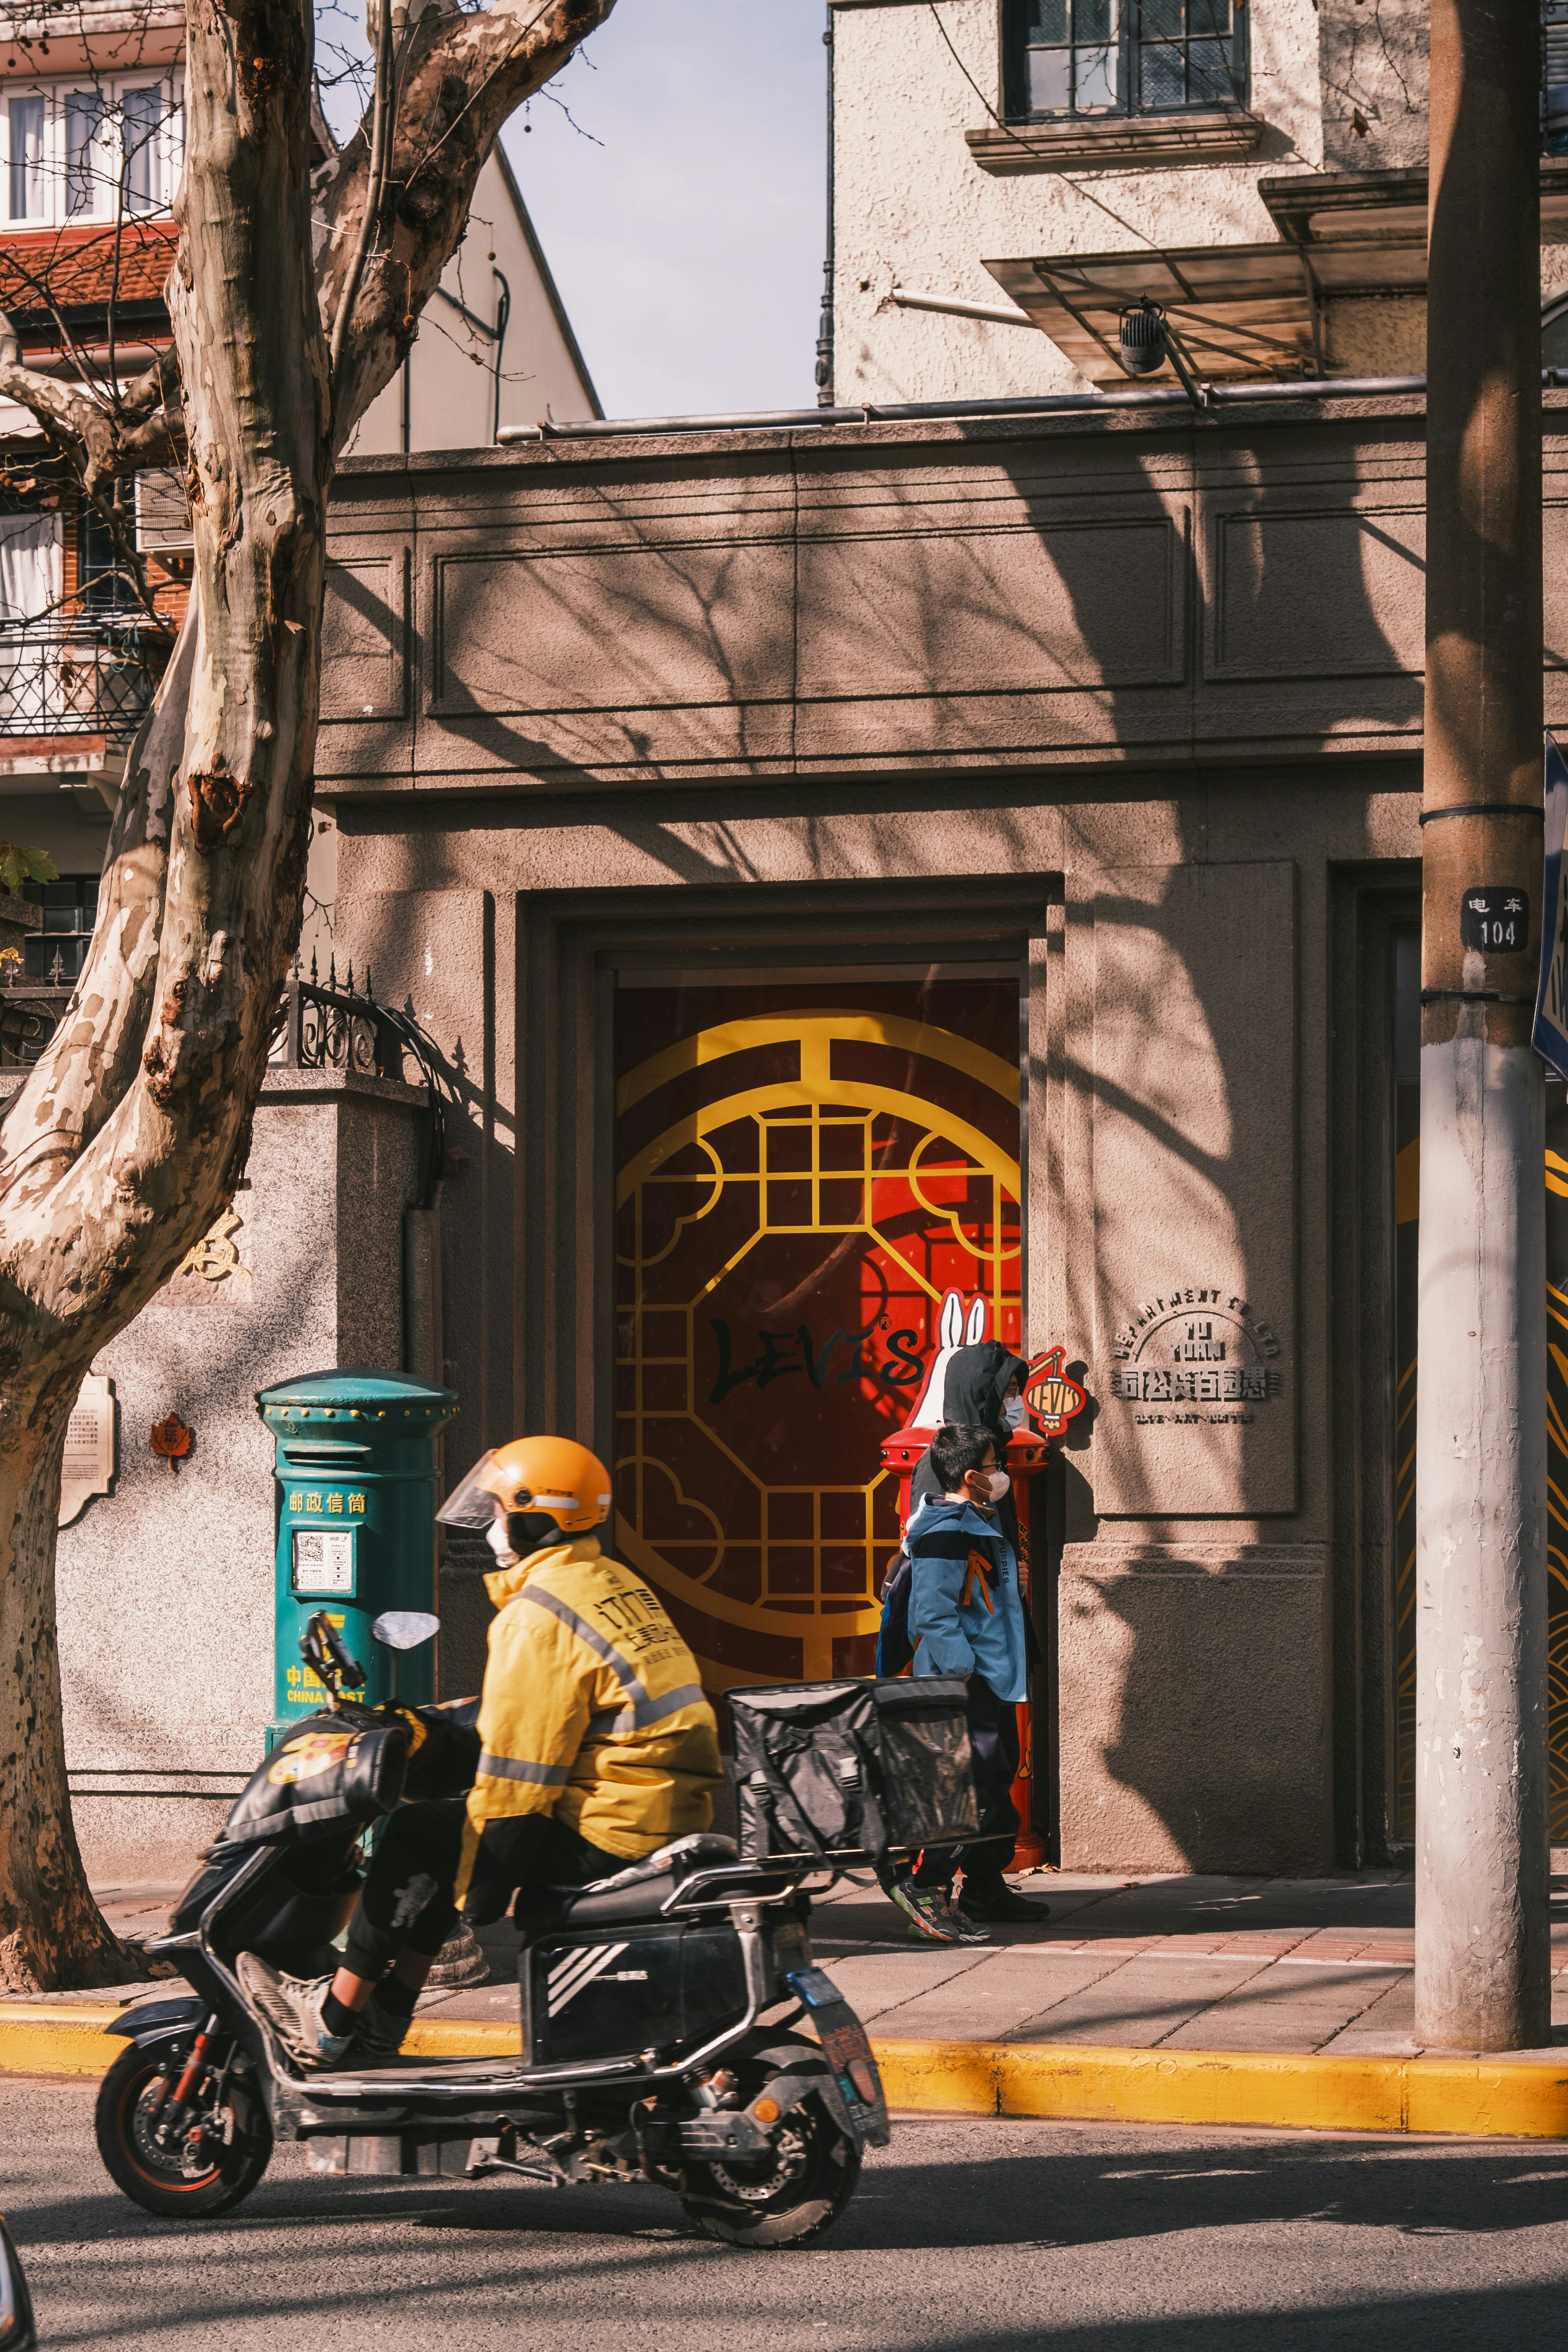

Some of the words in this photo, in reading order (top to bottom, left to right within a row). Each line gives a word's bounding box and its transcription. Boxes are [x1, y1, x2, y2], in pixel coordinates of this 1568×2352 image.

[1469, 898, 1522, 913] 电车
[1482, 921, 1515, 945] 104
[1111, 1286, 1219, 1360] DEPARTMENT
[1181, 1321, 1210, 1339] YU
[1167, 1340, 1223, 1360] YUAN
[289, 1492, 365, 1514] 邮政信筒
[998, 1539, 1009, 1584] PUPPIES
[287, 1690, 324, 1703] CHINA
